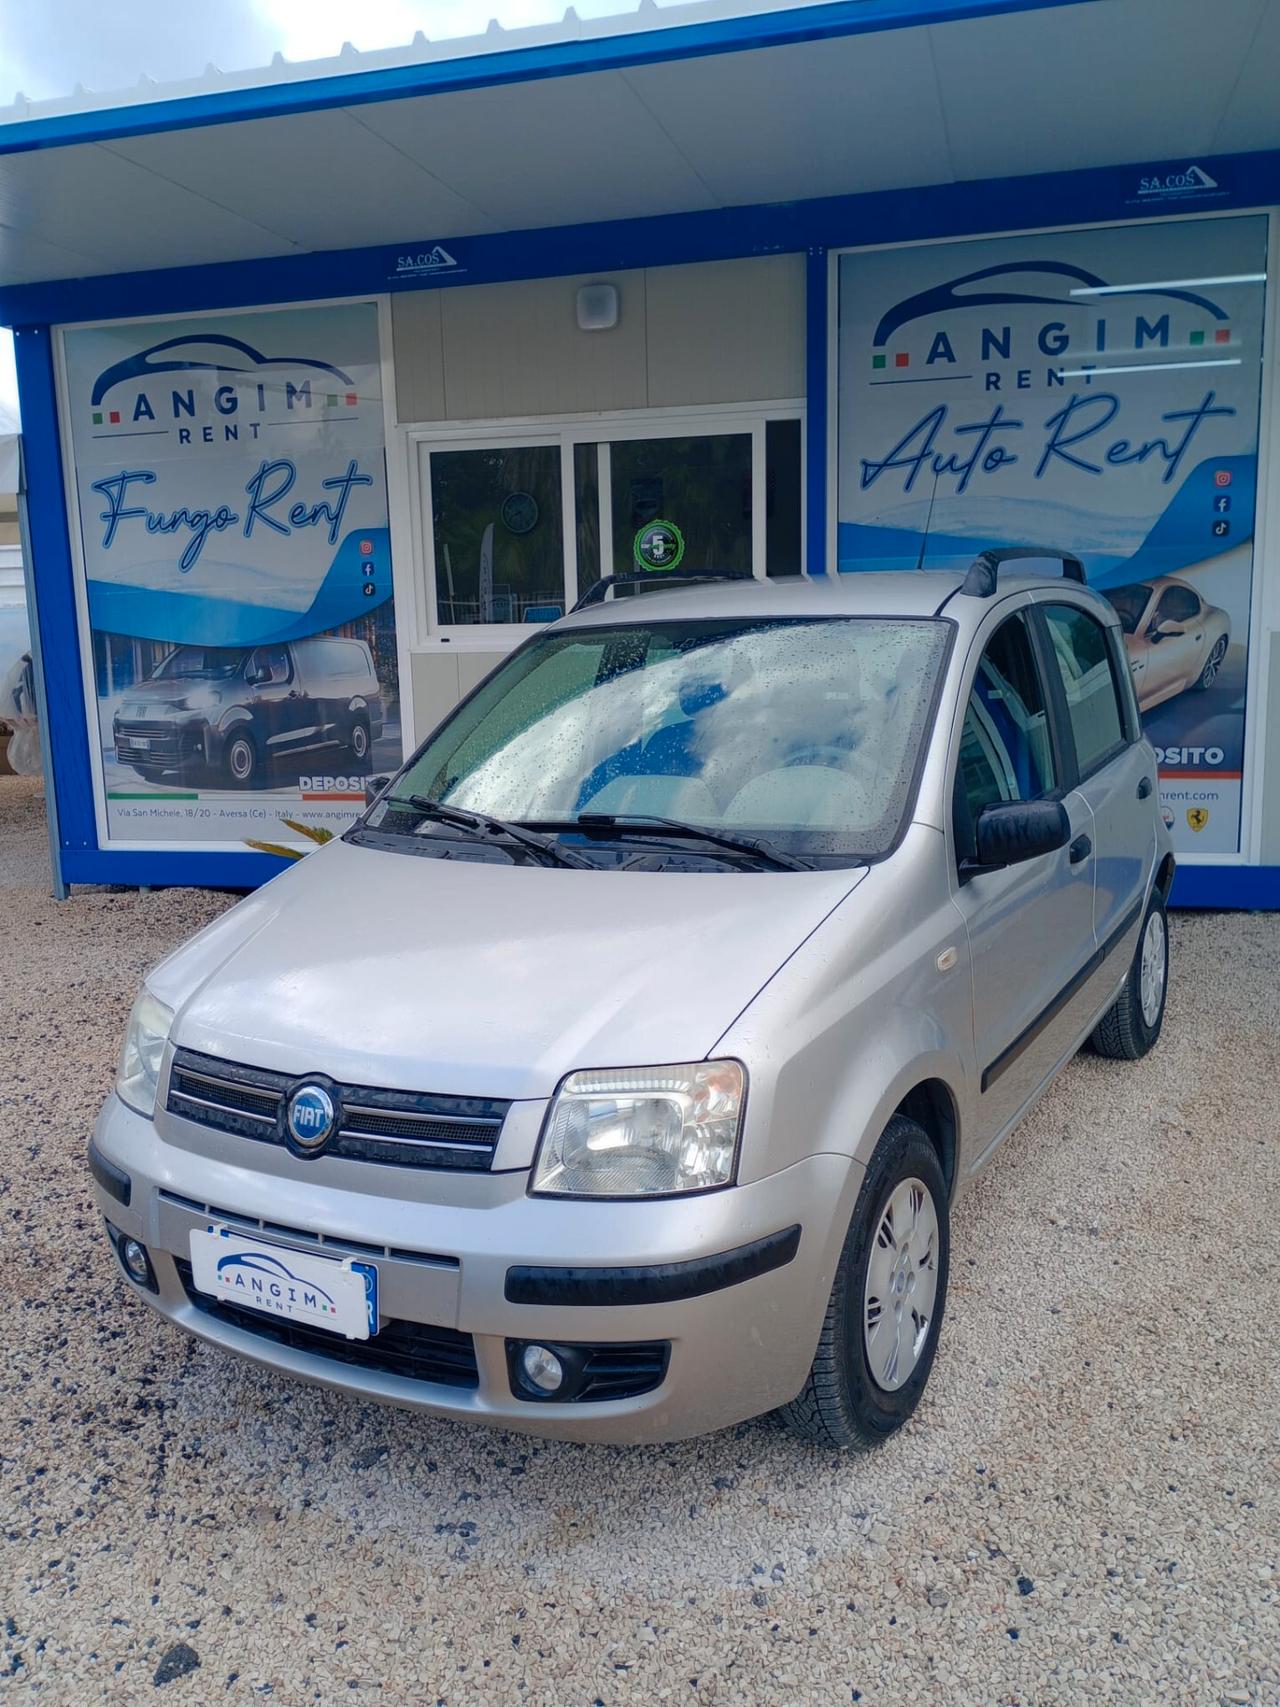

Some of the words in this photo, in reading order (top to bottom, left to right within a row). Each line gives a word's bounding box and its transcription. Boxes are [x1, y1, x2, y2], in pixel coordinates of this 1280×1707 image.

[926, 314, 1170, 365] ANGIM
[985, 365, 1097, 391] RENT
[132, 380, 312, 422] ANGIM
[179, 423, 261, 445] RENT
[860, 403, 1024, 494] Auto
[1034, 390, 1237, 484] Rent
[243, 458, 374, 545] Rent
[652, 535, 664, 555] 5
[117, 808, 131, 818] Via
[132, 808, 148, 818] San
[219, 809, 248, 819] Aversa
[249, 808, 267, 820] (Ce)
[275, 809, 293, 820] Italy
[293, 1104, 325, 1127] FIAT
[235, 1273, 317, 1308] ANGIM
[255, 1296, 293, 1313] RENT
